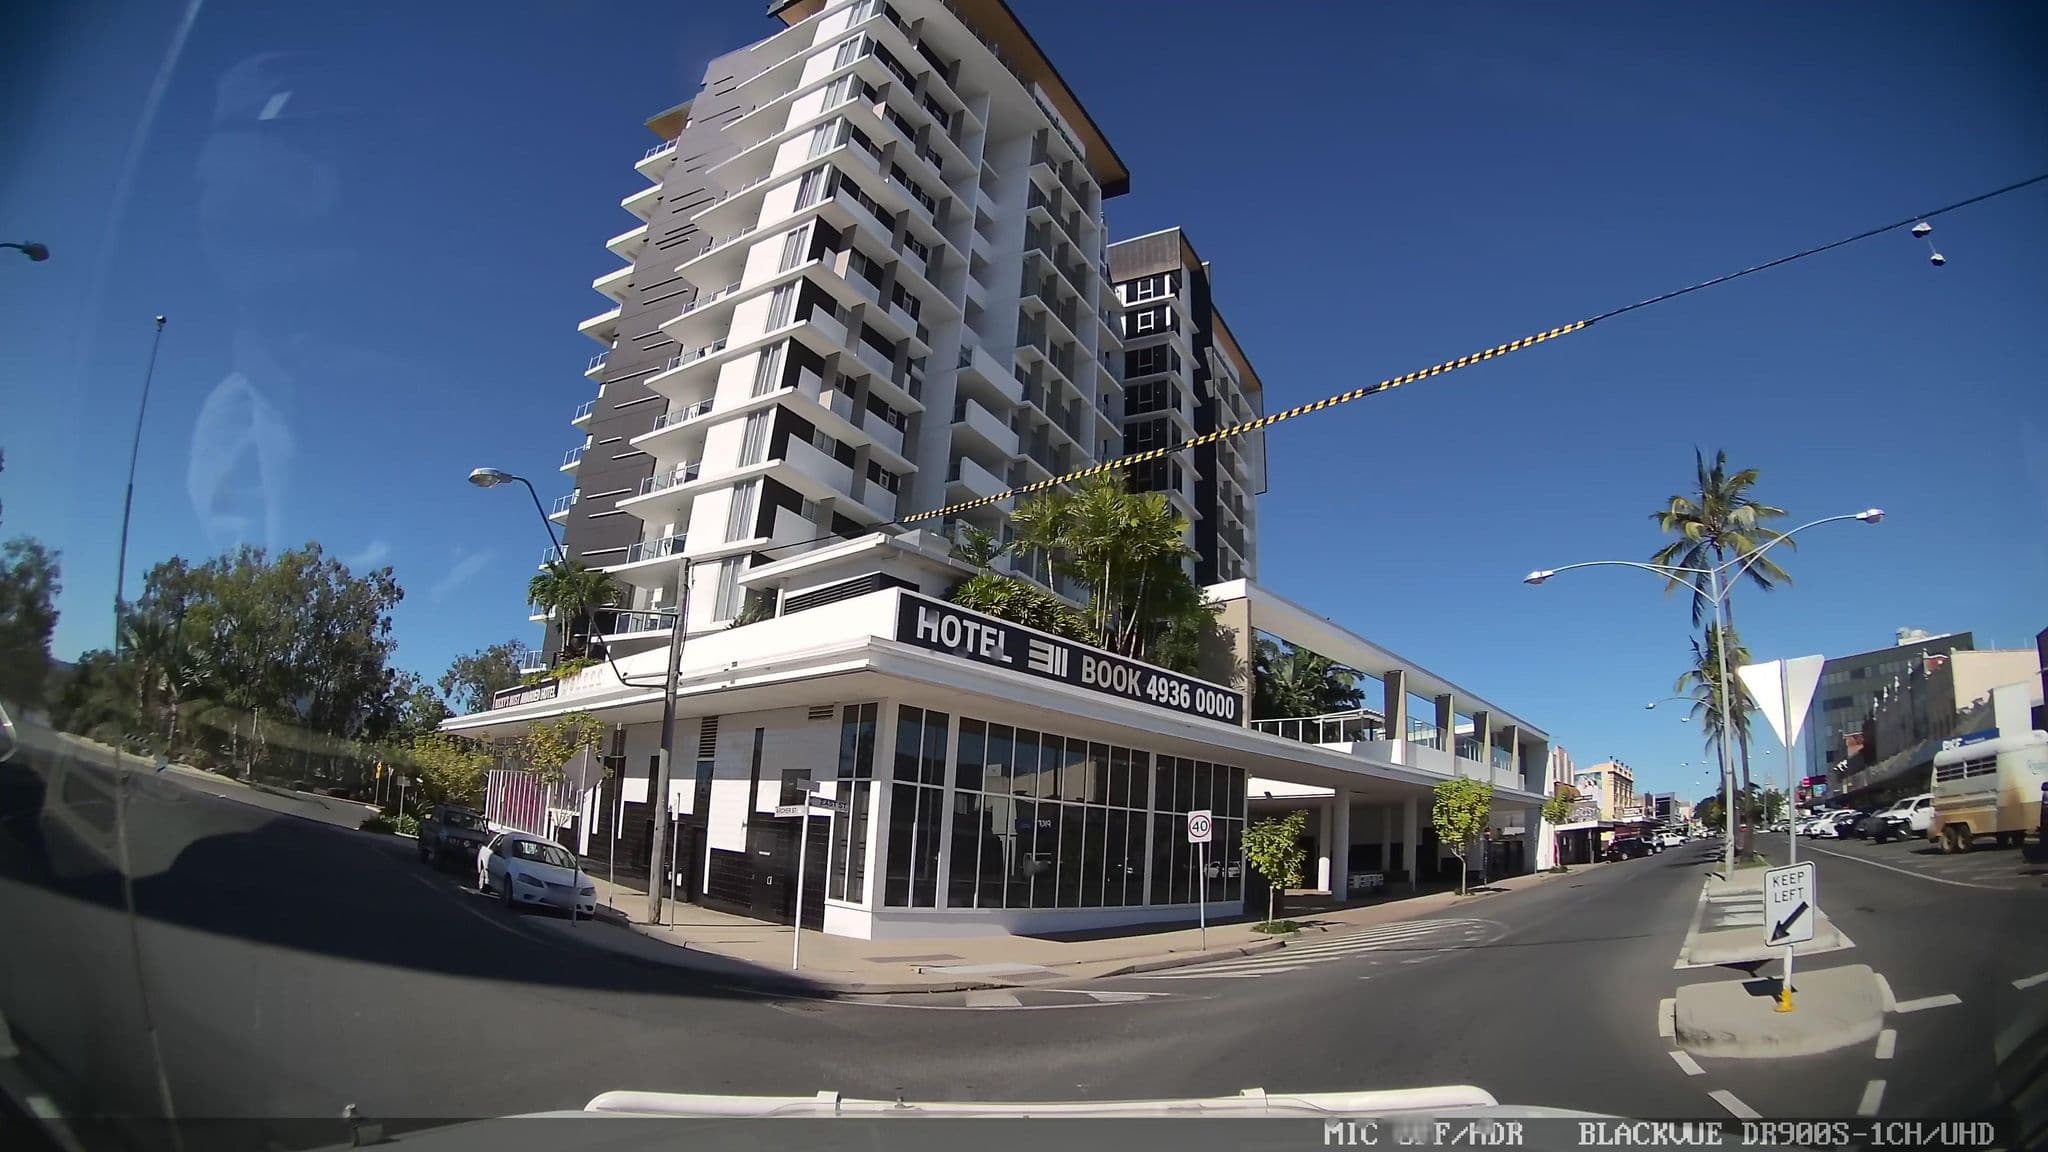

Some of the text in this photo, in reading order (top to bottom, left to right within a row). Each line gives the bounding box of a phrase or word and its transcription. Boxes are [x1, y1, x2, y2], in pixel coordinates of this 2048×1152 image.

[917, 606, 1013, 663] HOTEL
[1081, 655, 1141, 697] BOOK
[1146, 674, 1191, 708] 4936
[1195, 688, 1235, 719] 0000
[1192, 820, 1208, 832] 40
[1773, 871, 1805, 888] KEEP
[1774, 887, 1804, 903] LEFT
